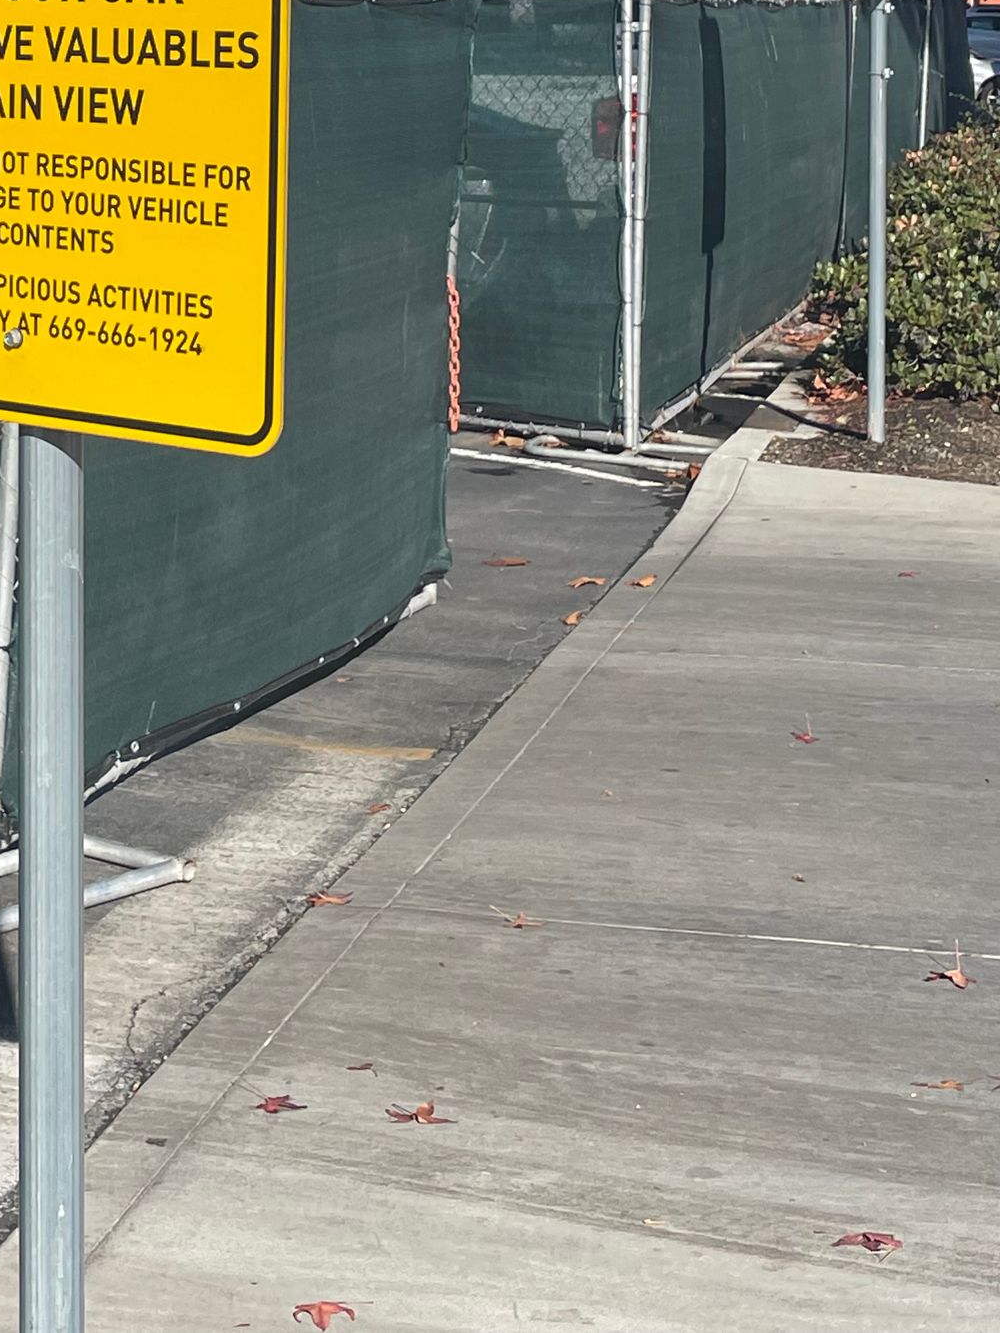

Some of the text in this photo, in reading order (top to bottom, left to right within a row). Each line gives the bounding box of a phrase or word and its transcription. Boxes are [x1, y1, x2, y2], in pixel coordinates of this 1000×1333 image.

[44, 25, 259, 70] VALUABLES
[53, 85, 144, 126] VIEW
[36, 153, 196, 187] RESPONSIBLE
[204, 164, 251, 191] FOR
[27, 188, 54, 213] TO
[61, 191, 121, 218] YOUR
[128, 196, 228, 227] VEHICLE
[87, 283, 213, 319] ACTIVITIES
[16, 312, 42, 336] AT
[49, 315, 202, 356] 669-666-1924
